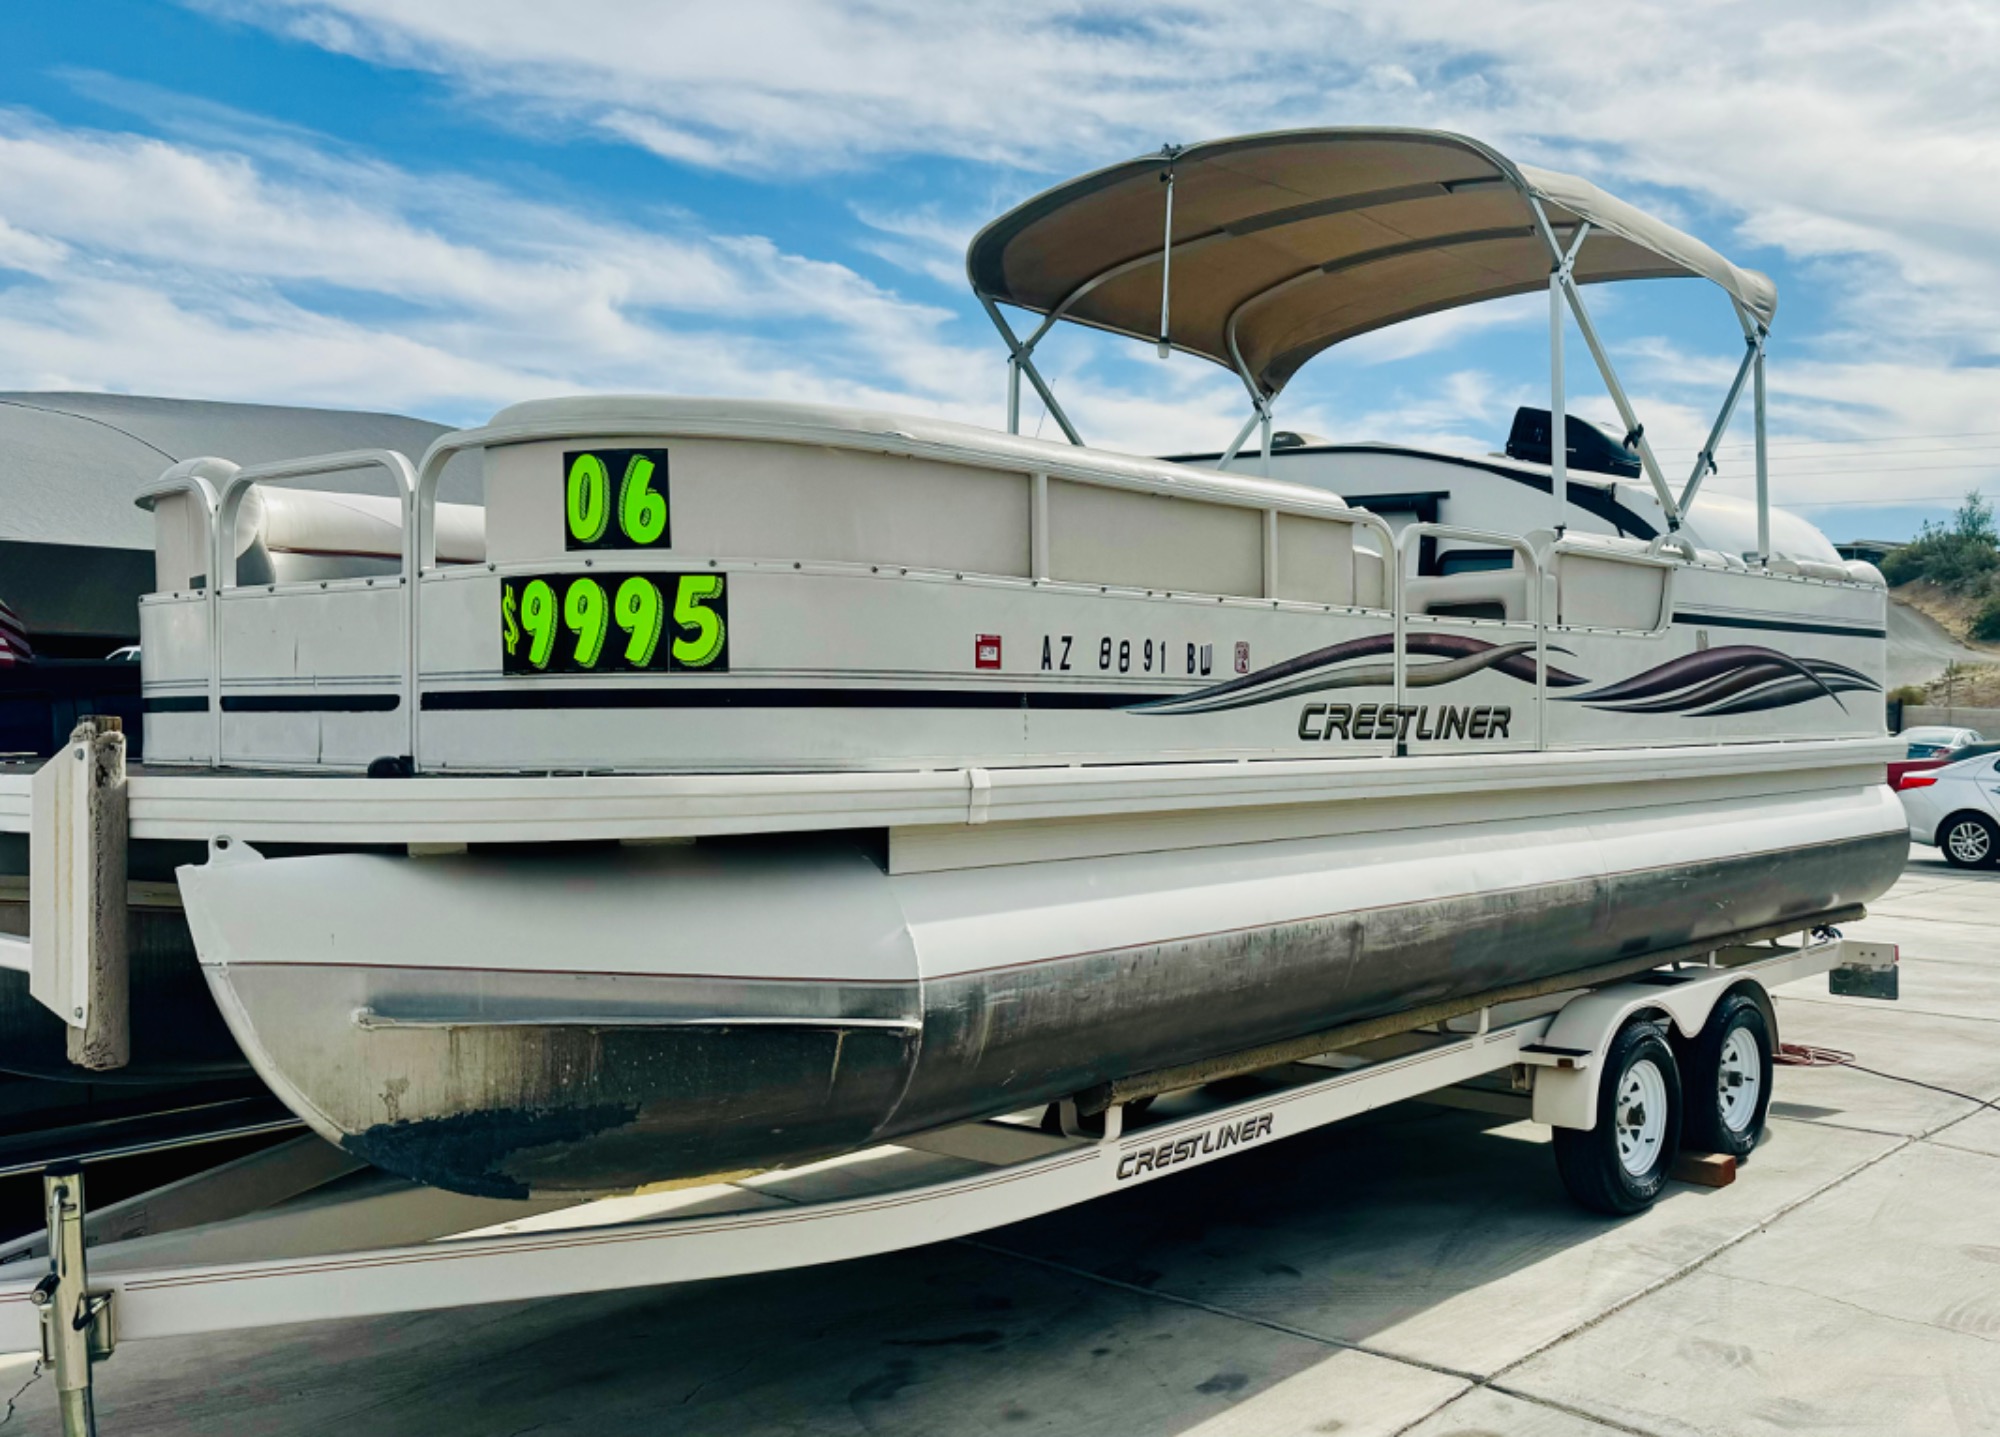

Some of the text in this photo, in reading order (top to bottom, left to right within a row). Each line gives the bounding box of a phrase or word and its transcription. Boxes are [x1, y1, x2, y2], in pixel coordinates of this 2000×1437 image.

[567, 453, 667, 544] 06
[502, 575, 725, 669] $9995
[1041, 634, 1073, 670] AZ
[1099, 636, 1166, 674] 8891
[1298, 702, 1512, 741] CRESTLINER
[1116, 1111, 1274, 1181] CRESTLINER
